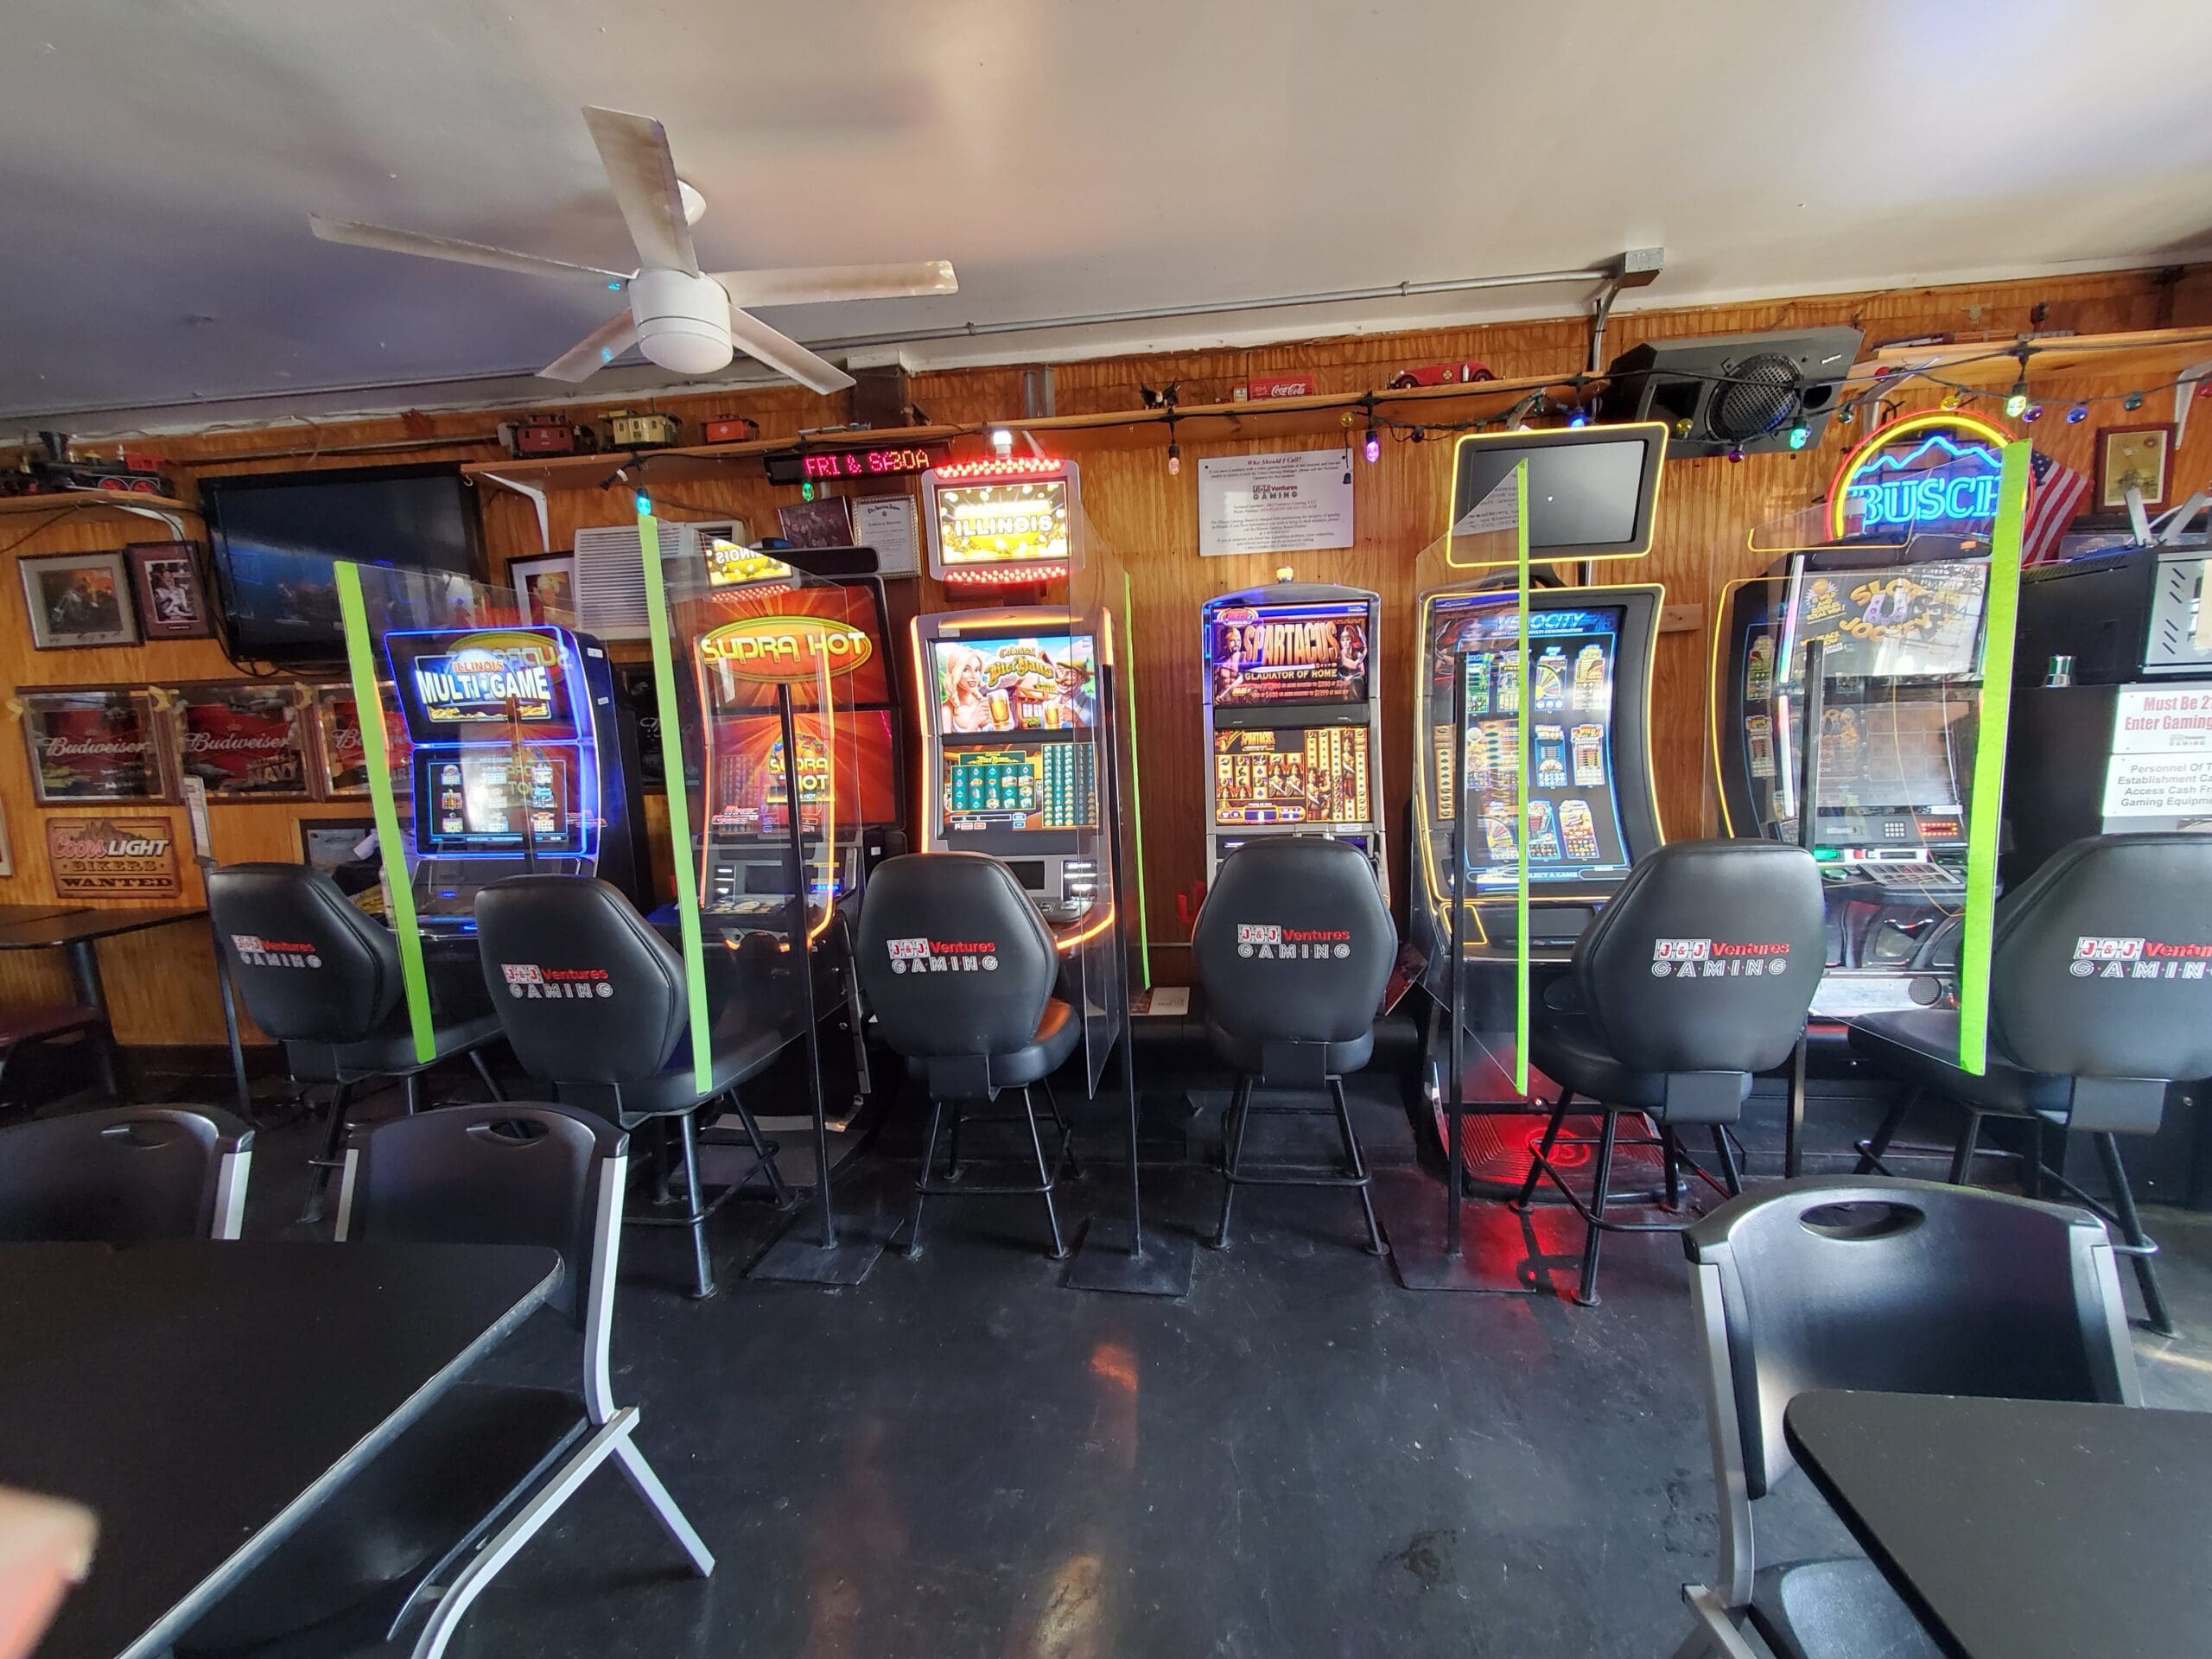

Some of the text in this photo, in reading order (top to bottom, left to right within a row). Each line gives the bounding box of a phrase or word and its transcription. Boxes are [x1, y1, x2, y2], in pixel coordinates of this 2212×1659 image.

[803, 455, 841, 476] FRI
[846, 454, 862, 474] &
[1262, 457, 1281, 466] Should
[1253, 491, 1298, 500] GAMING
[955, 514, 1054, 537] ILLINOIS
[1497, 613, 1586, 630] VEOCITY
[701, 632, 866, 664] SUPRA HOT
[1243, 622, 1339, 664] SPARTACUS
[452, 660, 505, 673] ILLINOIS
[1244, 669, 1338, 680] GLADIATOR OF ROME
[416, 666, 550, 703] MULTI GAME
[2144, 696, 2178, 711] Must
[2180, 696, 2198, 710] Be
[2125, 716, 2160, 731] Enter
[42, 737, 154, 756] Budweiser
[186, 733, 290, 752] Budweiser
[2131, 763, 2187, 774] Personnel
[2190, 763, 2203, 772] Of
[2118, 775, 2196, 785] Establishment
[2125, 787, 2164, 796] Access
[2168, 785, 2196, 795] Cash
[2121, 798, 2163, 808] Gaming
[50, 832, 170, 858] Coors LIGHT
[72, 861, 157, 872] BIKERS
[61, 878, 174, 887] WANTED
[1240, 926, 1351, 942] J&J Ventures
[890, 940, 995, 957] J&J Ventures
[1238, 943, 1351, 959] GAMING
[1657, 941, 1790, 959] J&J Ventures
[2077, 939, 2140, 958] J&J
[892, 956, 998, 974] GAMING
[1651, 958, 1787, 977] GAMING
[541, 968, 608, 980] Ventures
[509, 982, 613, 999] GAMING
